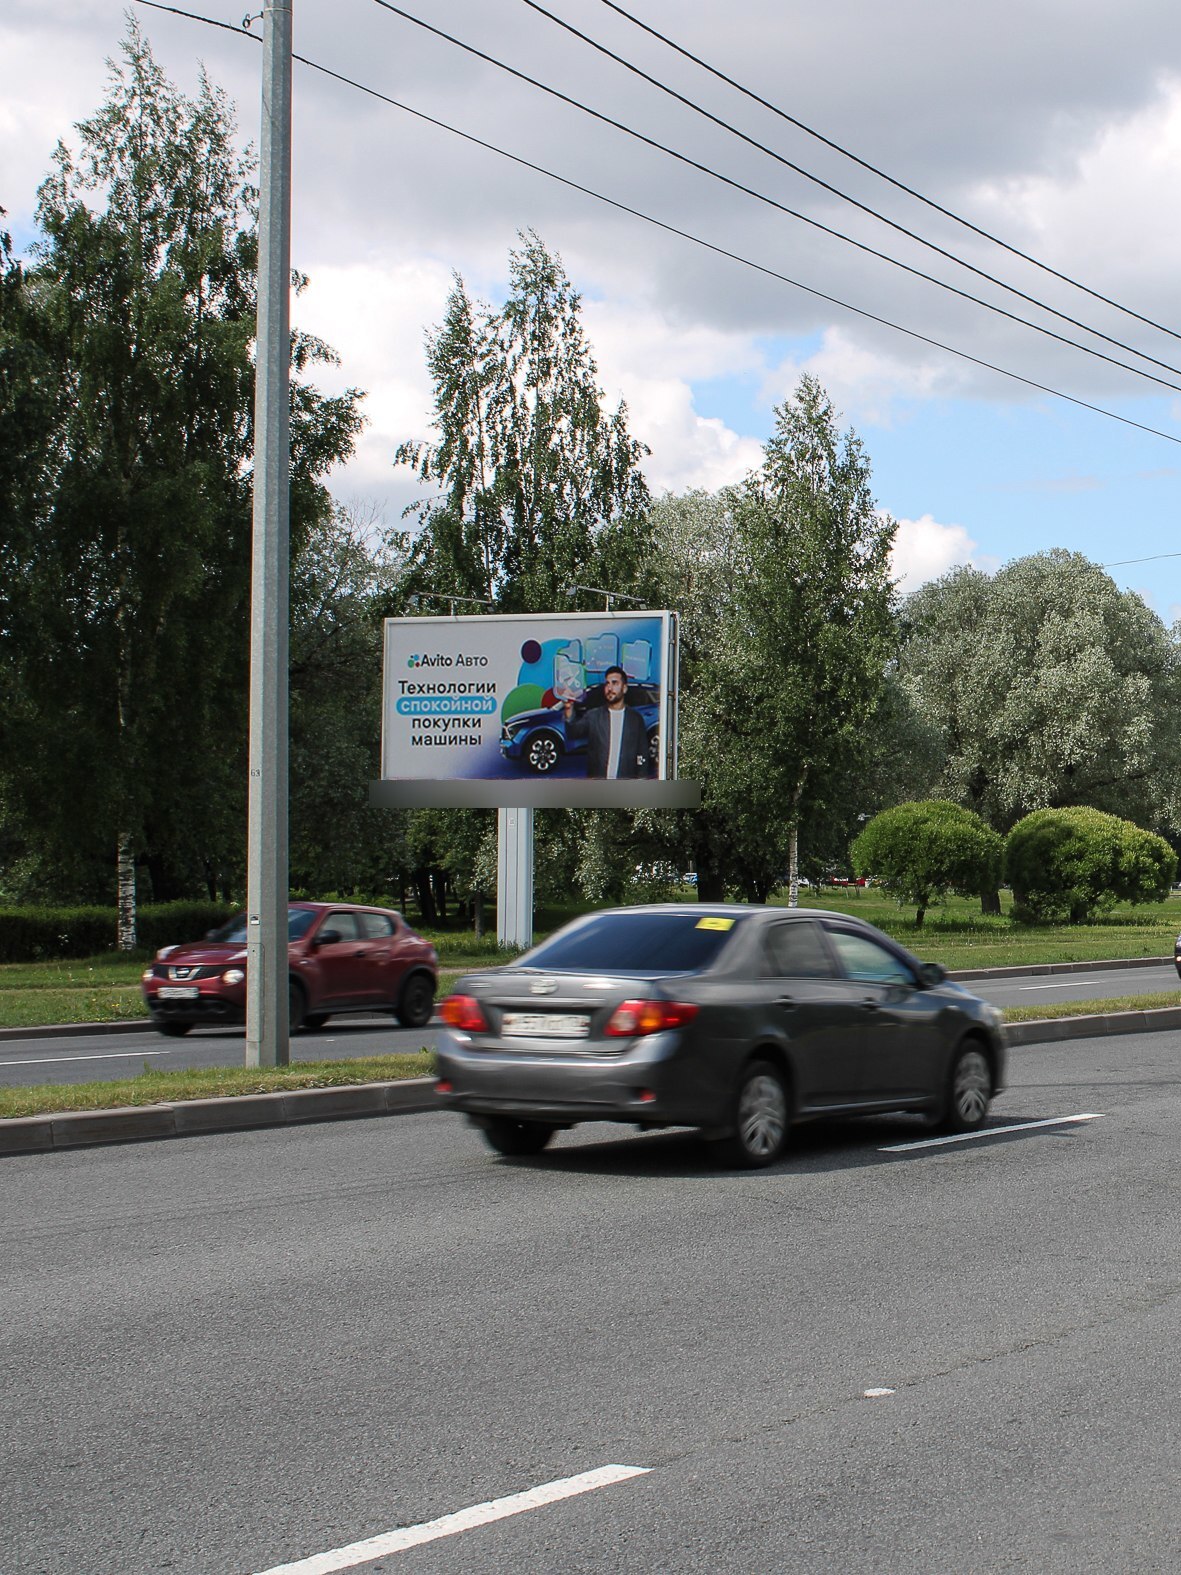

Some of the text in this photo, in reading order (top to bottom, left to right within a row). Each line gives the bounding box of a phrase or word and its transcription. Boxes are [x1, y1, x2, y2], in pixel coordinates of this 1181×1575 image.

[420, 653, 488, 667] Avito Авто
[398, 680, 497, 695] Технологии
[401, 696, 493, 712] спокойной
[412, 717, 482, 732] покупки
[411, 734, 482, 746] машины
